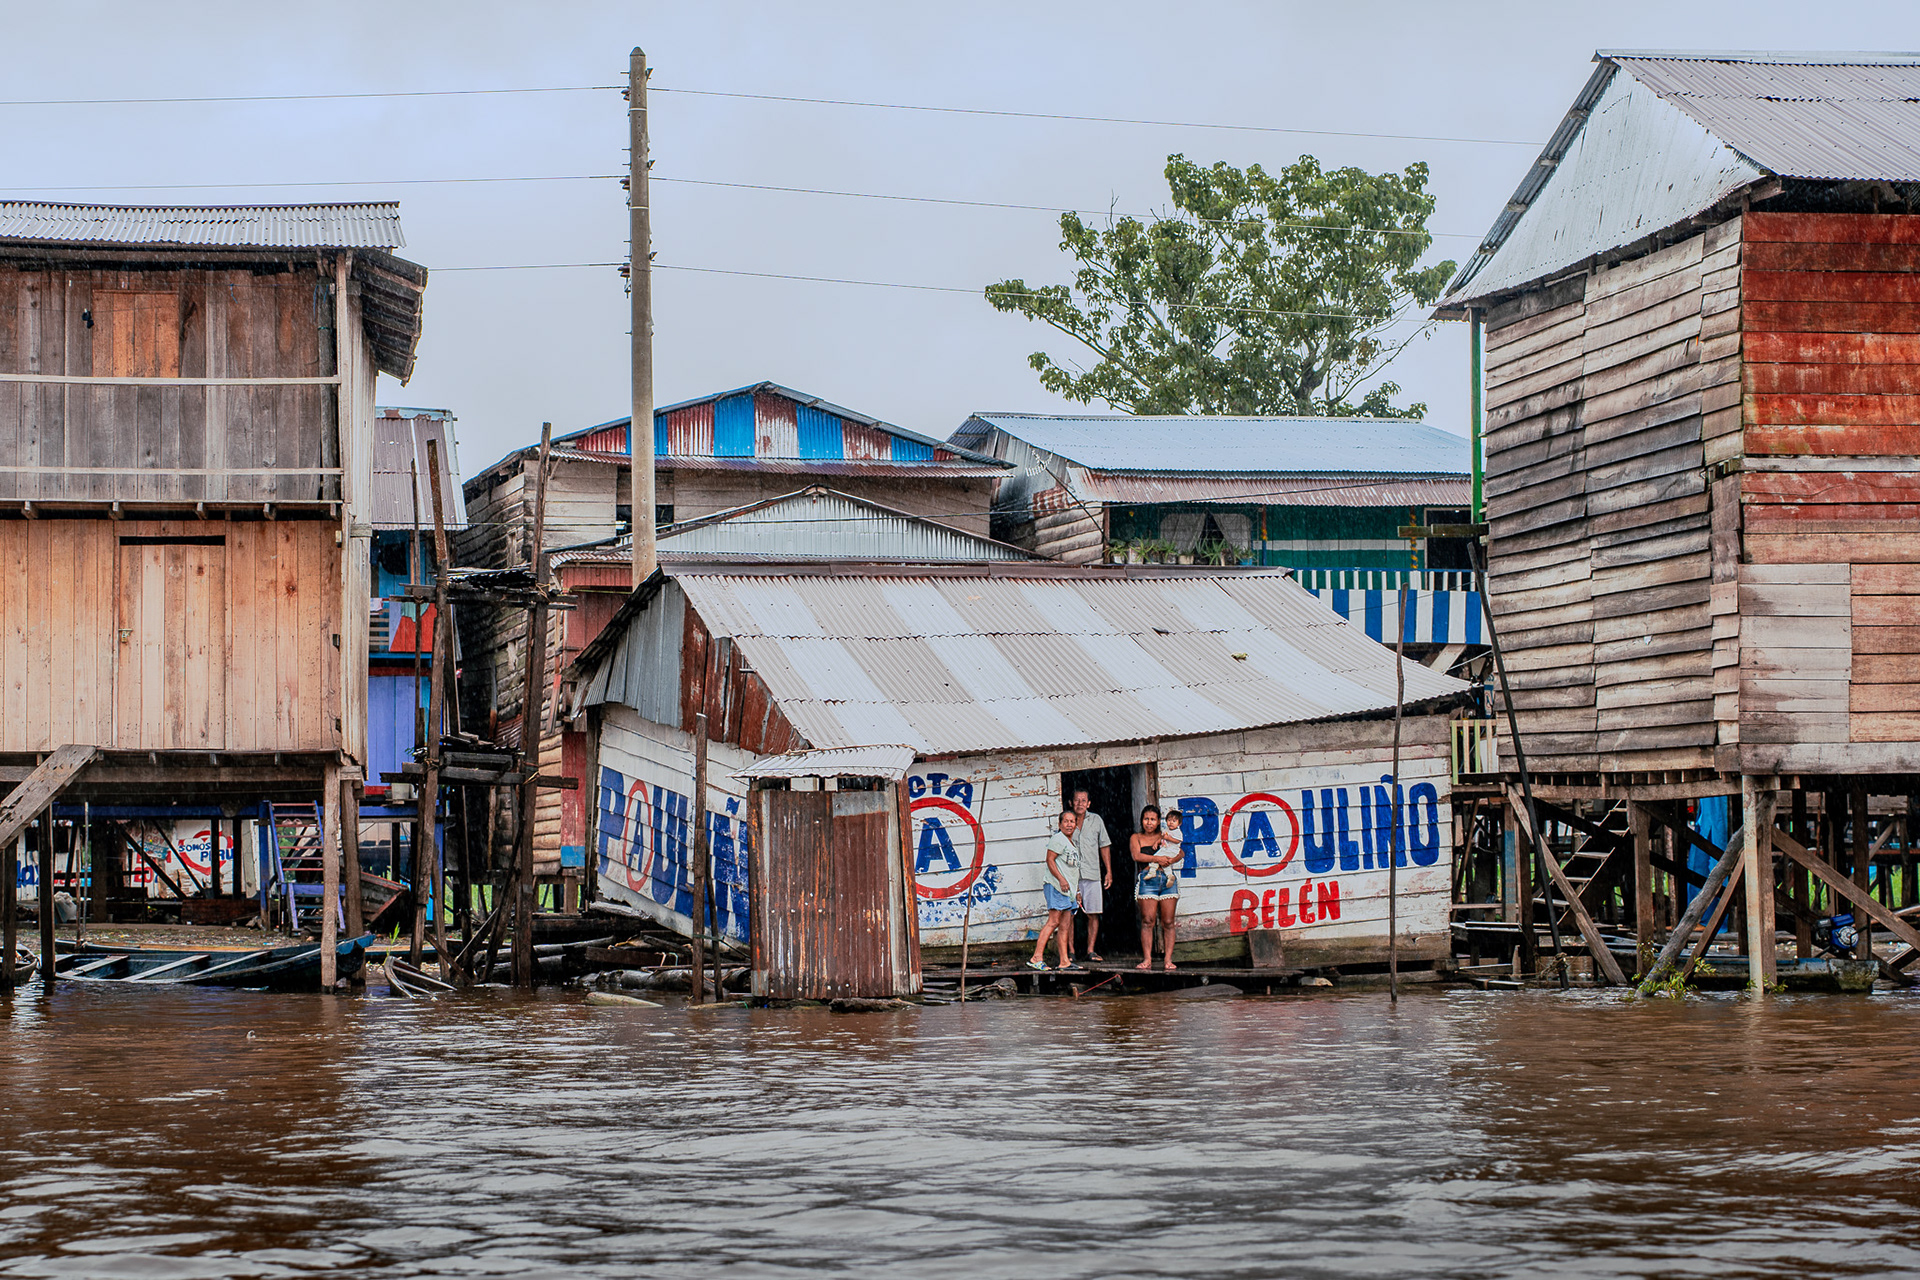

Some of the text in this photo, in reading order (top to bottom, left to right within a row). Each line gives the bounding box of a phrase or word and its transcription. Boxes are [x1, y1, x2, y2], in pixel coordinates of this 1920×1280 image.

[908, 773, 973, 809] OTA
[1177, 773, 1440, 879] PAULIÑO
[178, 842, 211, 852] SOMOS
[200, 848, 234, 862] PRU
[1230, 878, 1341, 935] BELÉN
